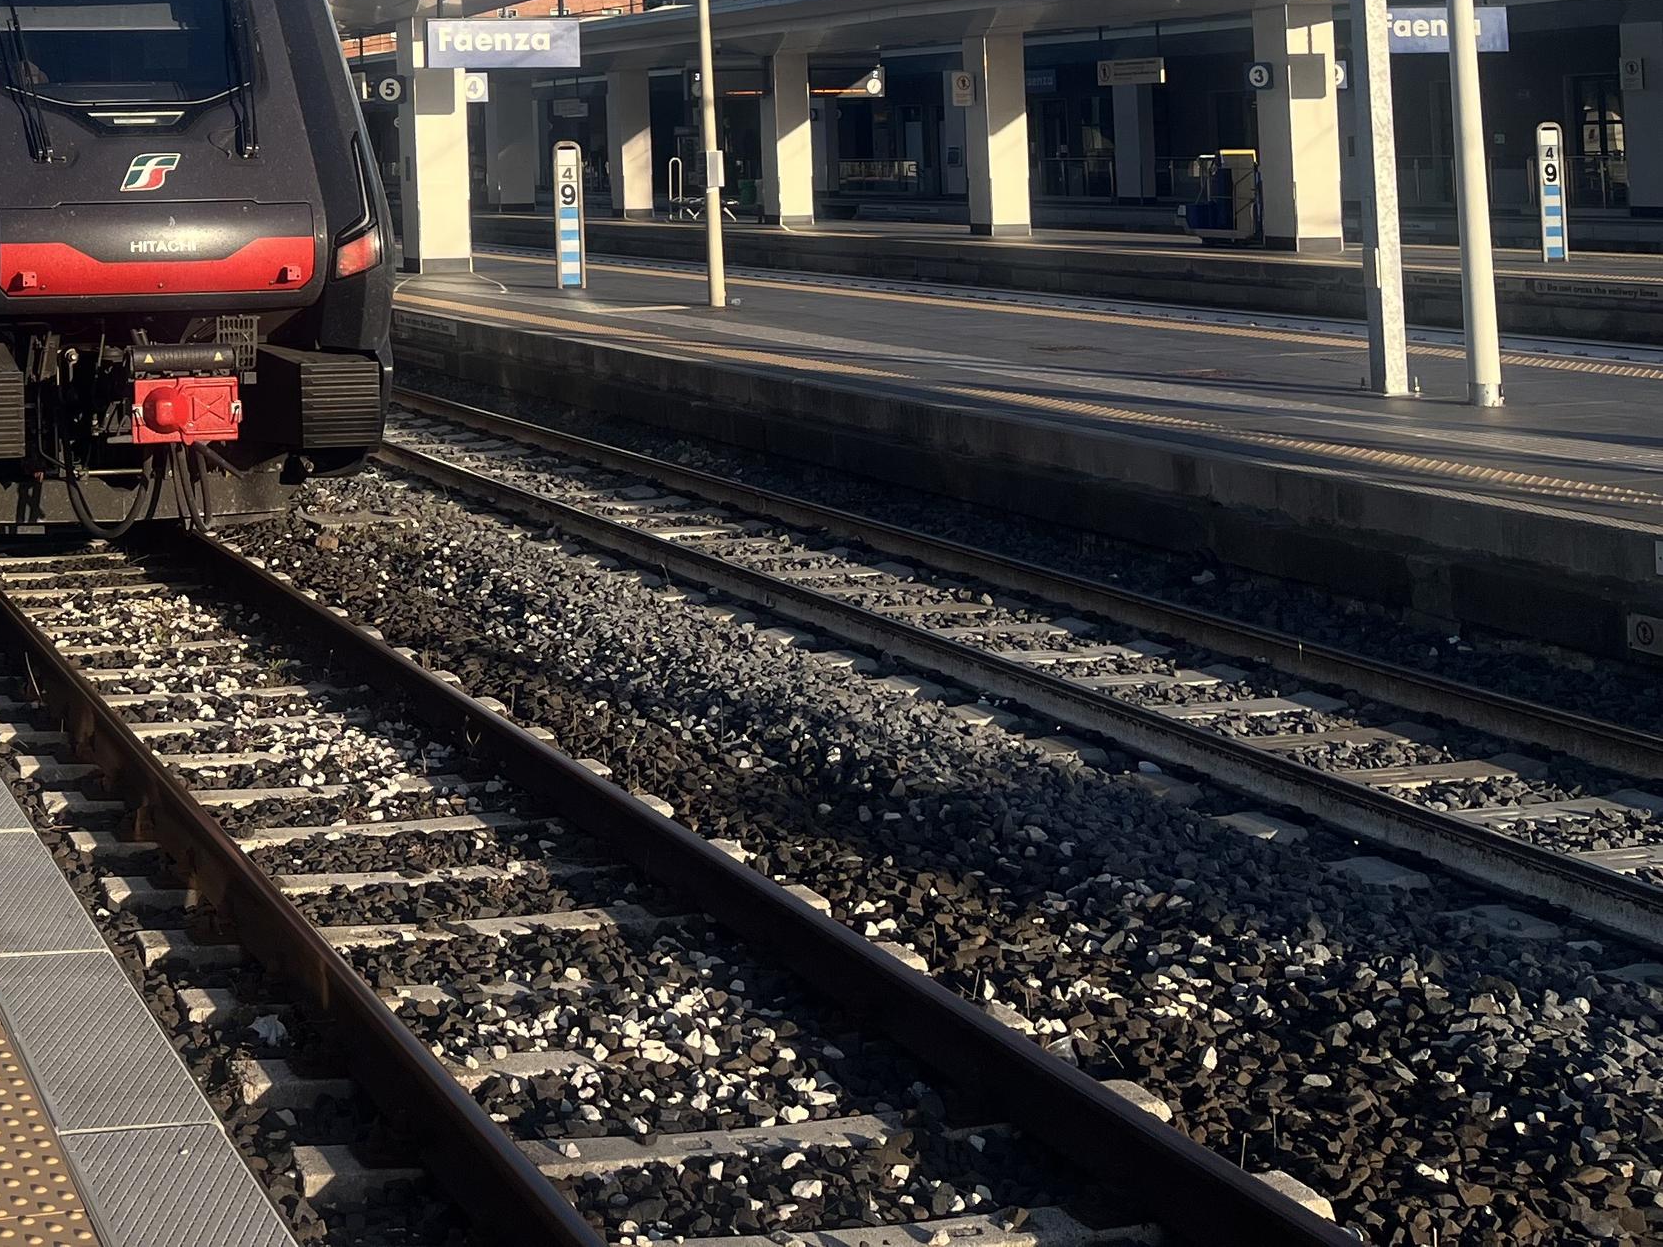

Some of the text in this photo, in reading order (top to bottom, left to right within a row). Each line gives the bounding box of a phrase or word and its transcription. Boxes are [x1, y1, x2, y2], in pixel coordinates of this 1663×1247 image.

[438, 26, 551, 52] Faenza
[1254, 68, 1264, 83] 3
[385, 82, 396, 97] 5
[467, 79, 479, 94] 4
[1545, 146, 1554, 159] 4
[561, 167, 573, 180] 4
[1544, 163, 1558, 183] 9
[560, 183, 576, 206] 9
[130, 240, 198, 253] HITACHI
